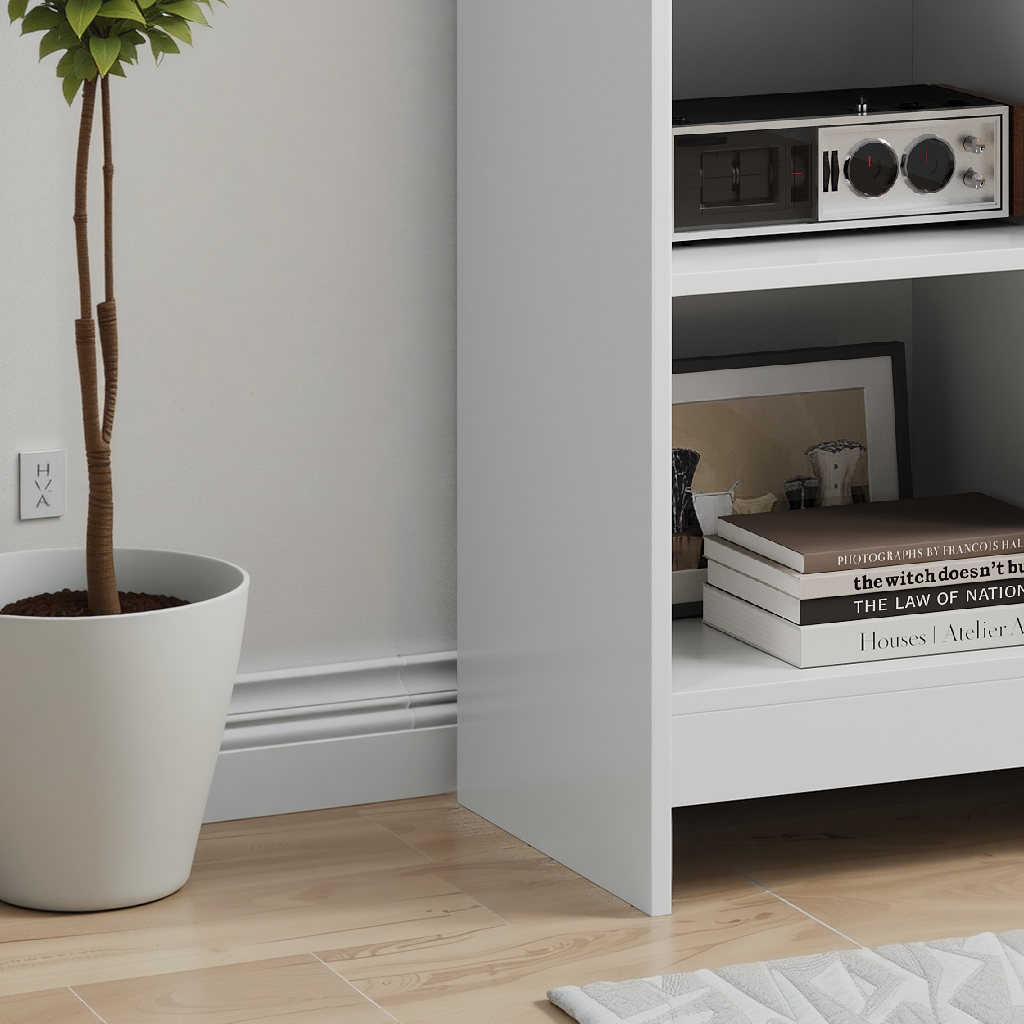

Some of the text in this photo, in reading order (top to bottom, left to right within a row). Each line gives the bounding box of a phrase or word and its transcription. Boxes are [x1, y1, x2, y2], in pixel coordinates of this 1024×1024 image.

[837, 547, 923, 566] PHOTOGRAPHS
[926, 545, 940, 558] BY
[854, 575, 884, 592] the
[886, 568, 936, 588] witch
[854, 598, 888, 614] THE
[895, 594, 931, 611] LAW
[936, 591, 959, 607] OF
[860, 630, 928, 653] Houses
[942, 618, 1008, 644] Atelier
